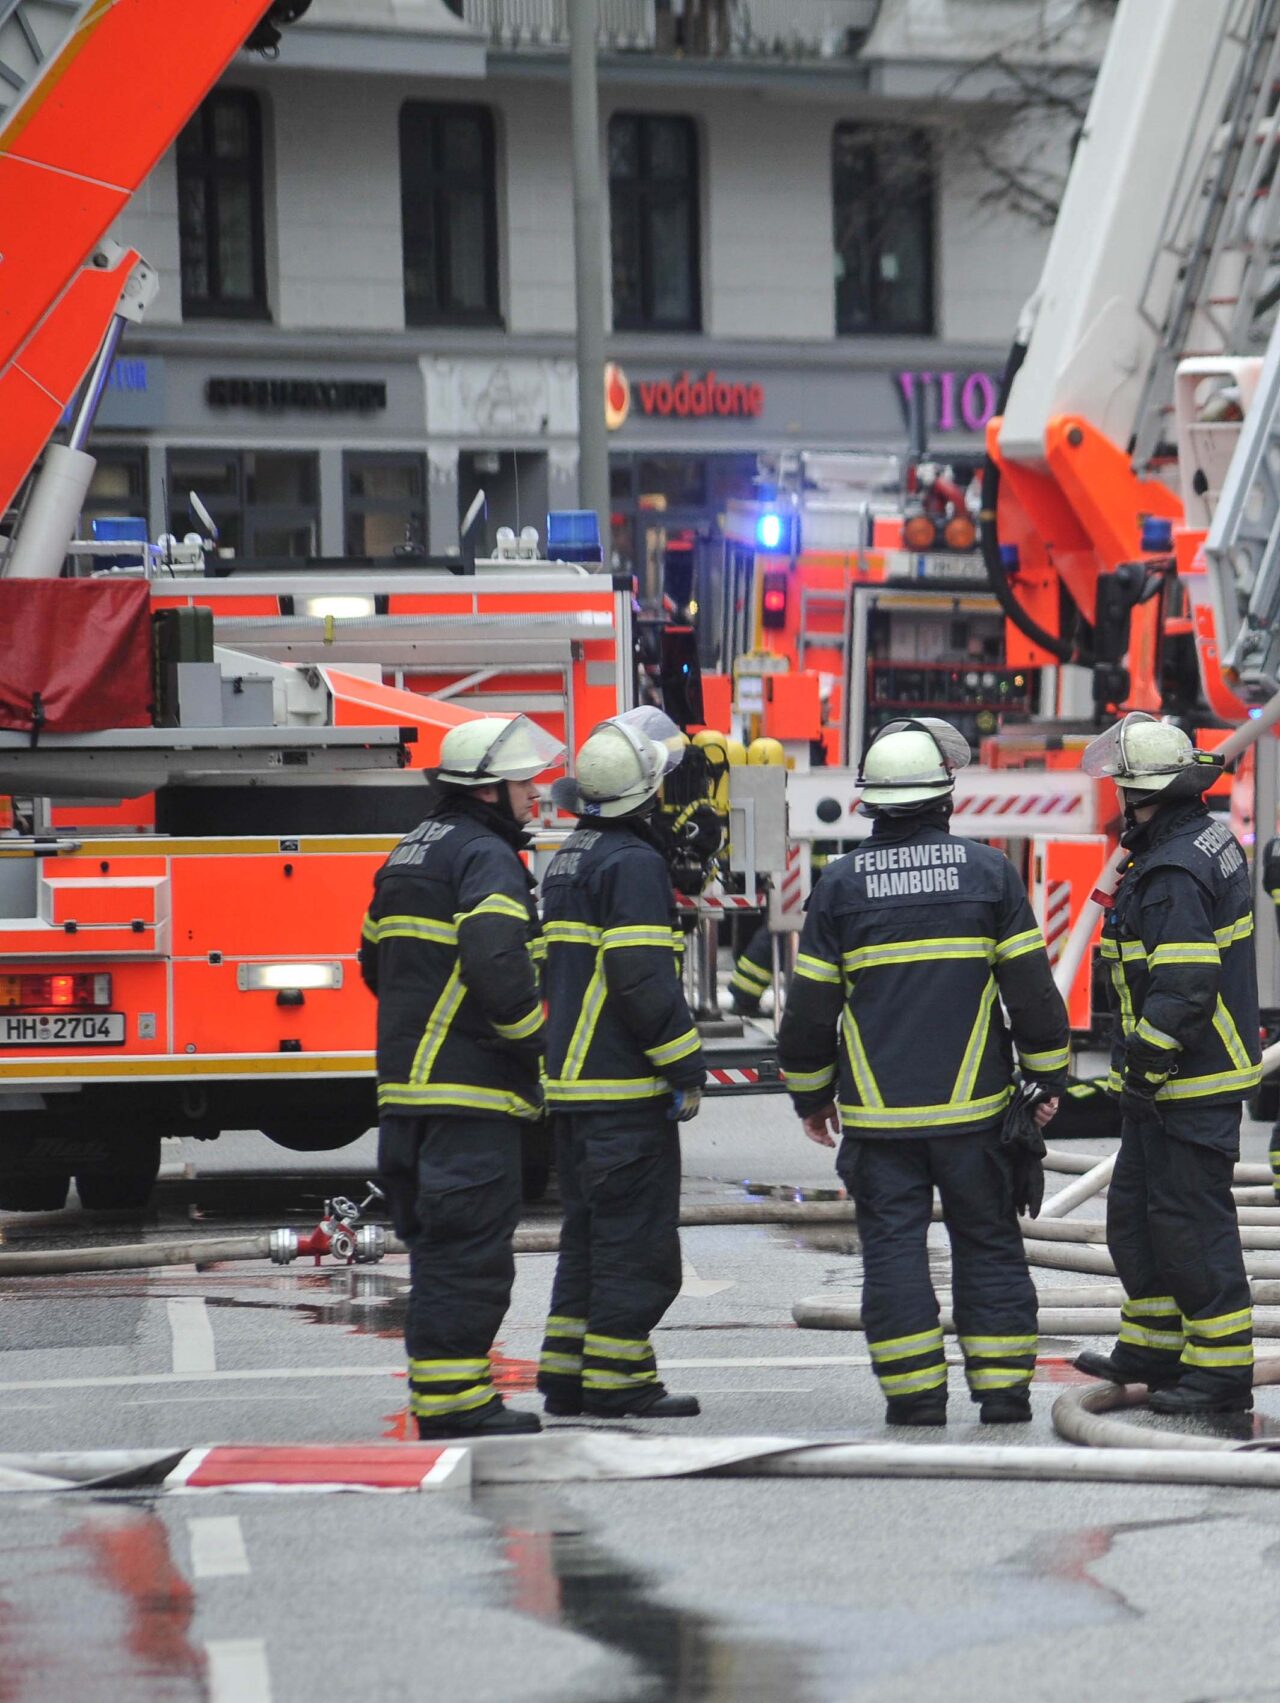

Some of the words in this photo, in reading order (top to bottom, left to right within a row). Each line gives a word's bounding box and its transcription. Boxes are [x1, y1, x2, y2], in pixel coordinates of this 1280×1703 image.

[639, 370, 766, 417] vodafone
[854, 843, 967, 873] FEUERWEHR
[865, 866, 960, 898] HAMBURG
[6, 1018, 38, 1040] HH
[53, 1017, 111, 1040] 2704
